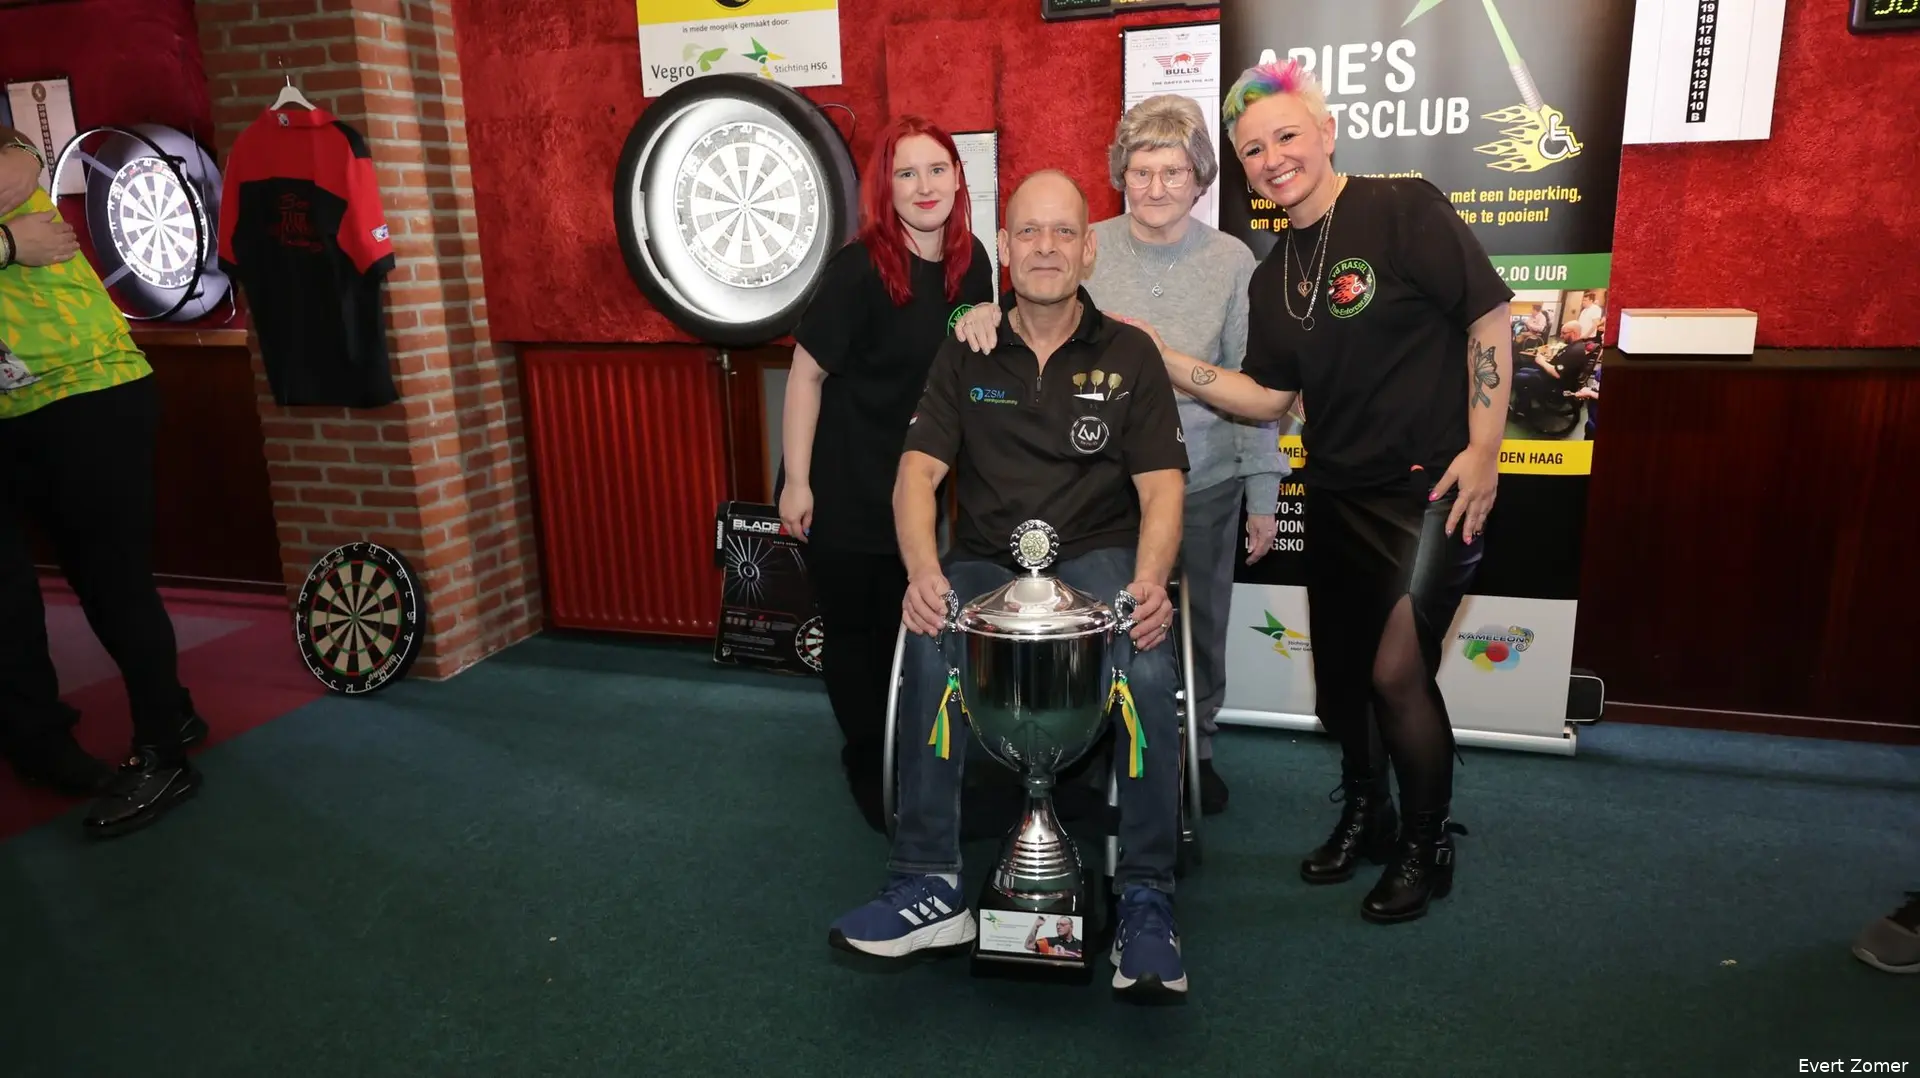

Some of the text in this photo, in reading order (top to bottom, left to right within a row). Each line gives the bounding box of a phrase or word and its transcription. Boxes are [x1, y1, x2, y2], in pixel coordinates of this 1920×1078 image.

[1701, 3, 1715, 12] 19
[1700, 14, 1714, 23] 18
[689, 24, 708, 33] mede
[710, 22, 738, 35] mogelijk
[740, 19, 770, 30] gemaakt
[1699, 25, 1713, 34] 17
[1698, 36, 1712, 45] 16
[1696, 47, 1710, 57] 15
[774, 62, 828, 74] Stichting HSG
[1695, 58, 1709, 68] 14
[651, 64, 694, 82] Vegro
[1693, 69, 1708, 78] 13
[1692, 80, 1707, 89] 12
[1691, 91, 1704, 100] 11
[1690, 102, 1704, 111] 10
[1325, 97, 1470, 140] TSCLUB
[1450, 186, 1582, 204] met een beperking,
[1480, 209, 1494, 223] te
[1498, 207, 1549, 226] gooien!
[1251, 217, 1291, 232] om ge
[1496, 265, 1568, 281] 2.00 UUR
[984, 389, 1005, 398] ZSM
[1500, 452, 1525, 464] DEN
[1529, 452, 1564, 465] HAAG
[733, 519, 781, 532] BLADE
[1458, 632, 1525, 643] KAMELEON
